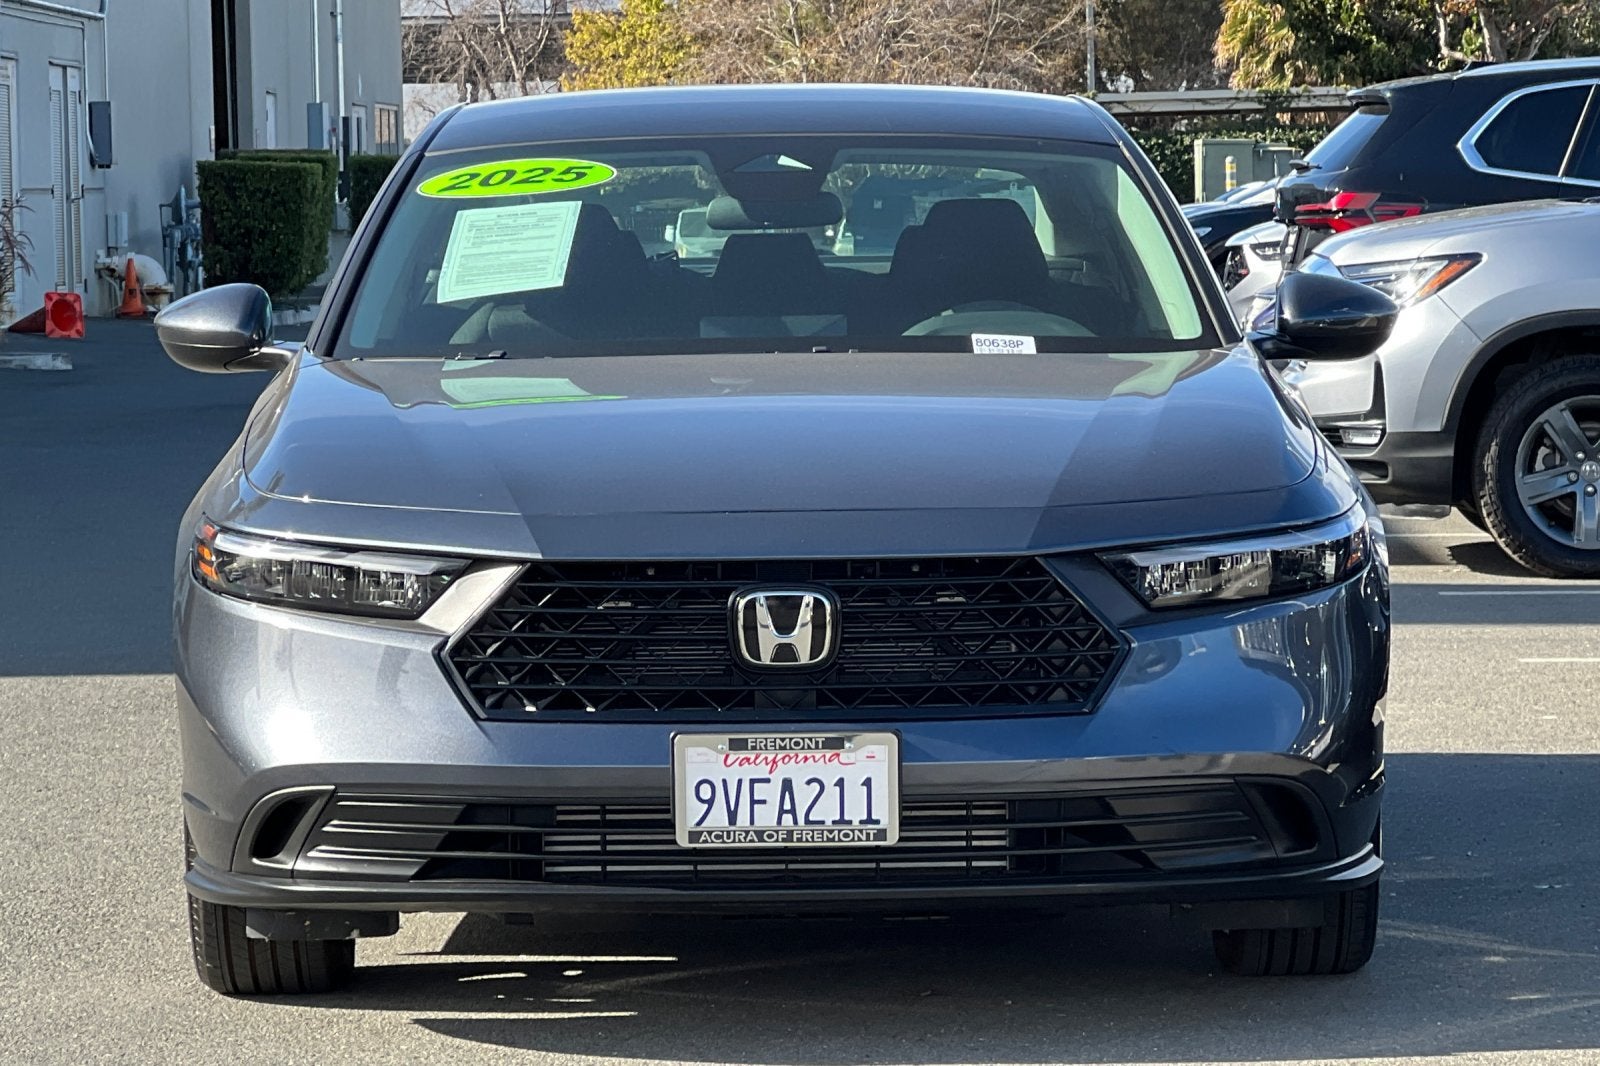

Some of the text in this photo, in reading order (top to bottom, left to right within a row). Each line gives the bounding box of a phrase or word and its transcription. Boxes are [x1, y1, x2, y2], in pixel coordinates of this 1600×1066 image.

[437, 166, 595, 193] 2025
[976, 338, 1023, 348] 80638P
[747, 737, 826, 750] FREMONT
[723, 751, 856, 775] California
[694, 776, 881, 828] 9VFA211
[699, 829, 878, 844] ACURA OF FREMONT
